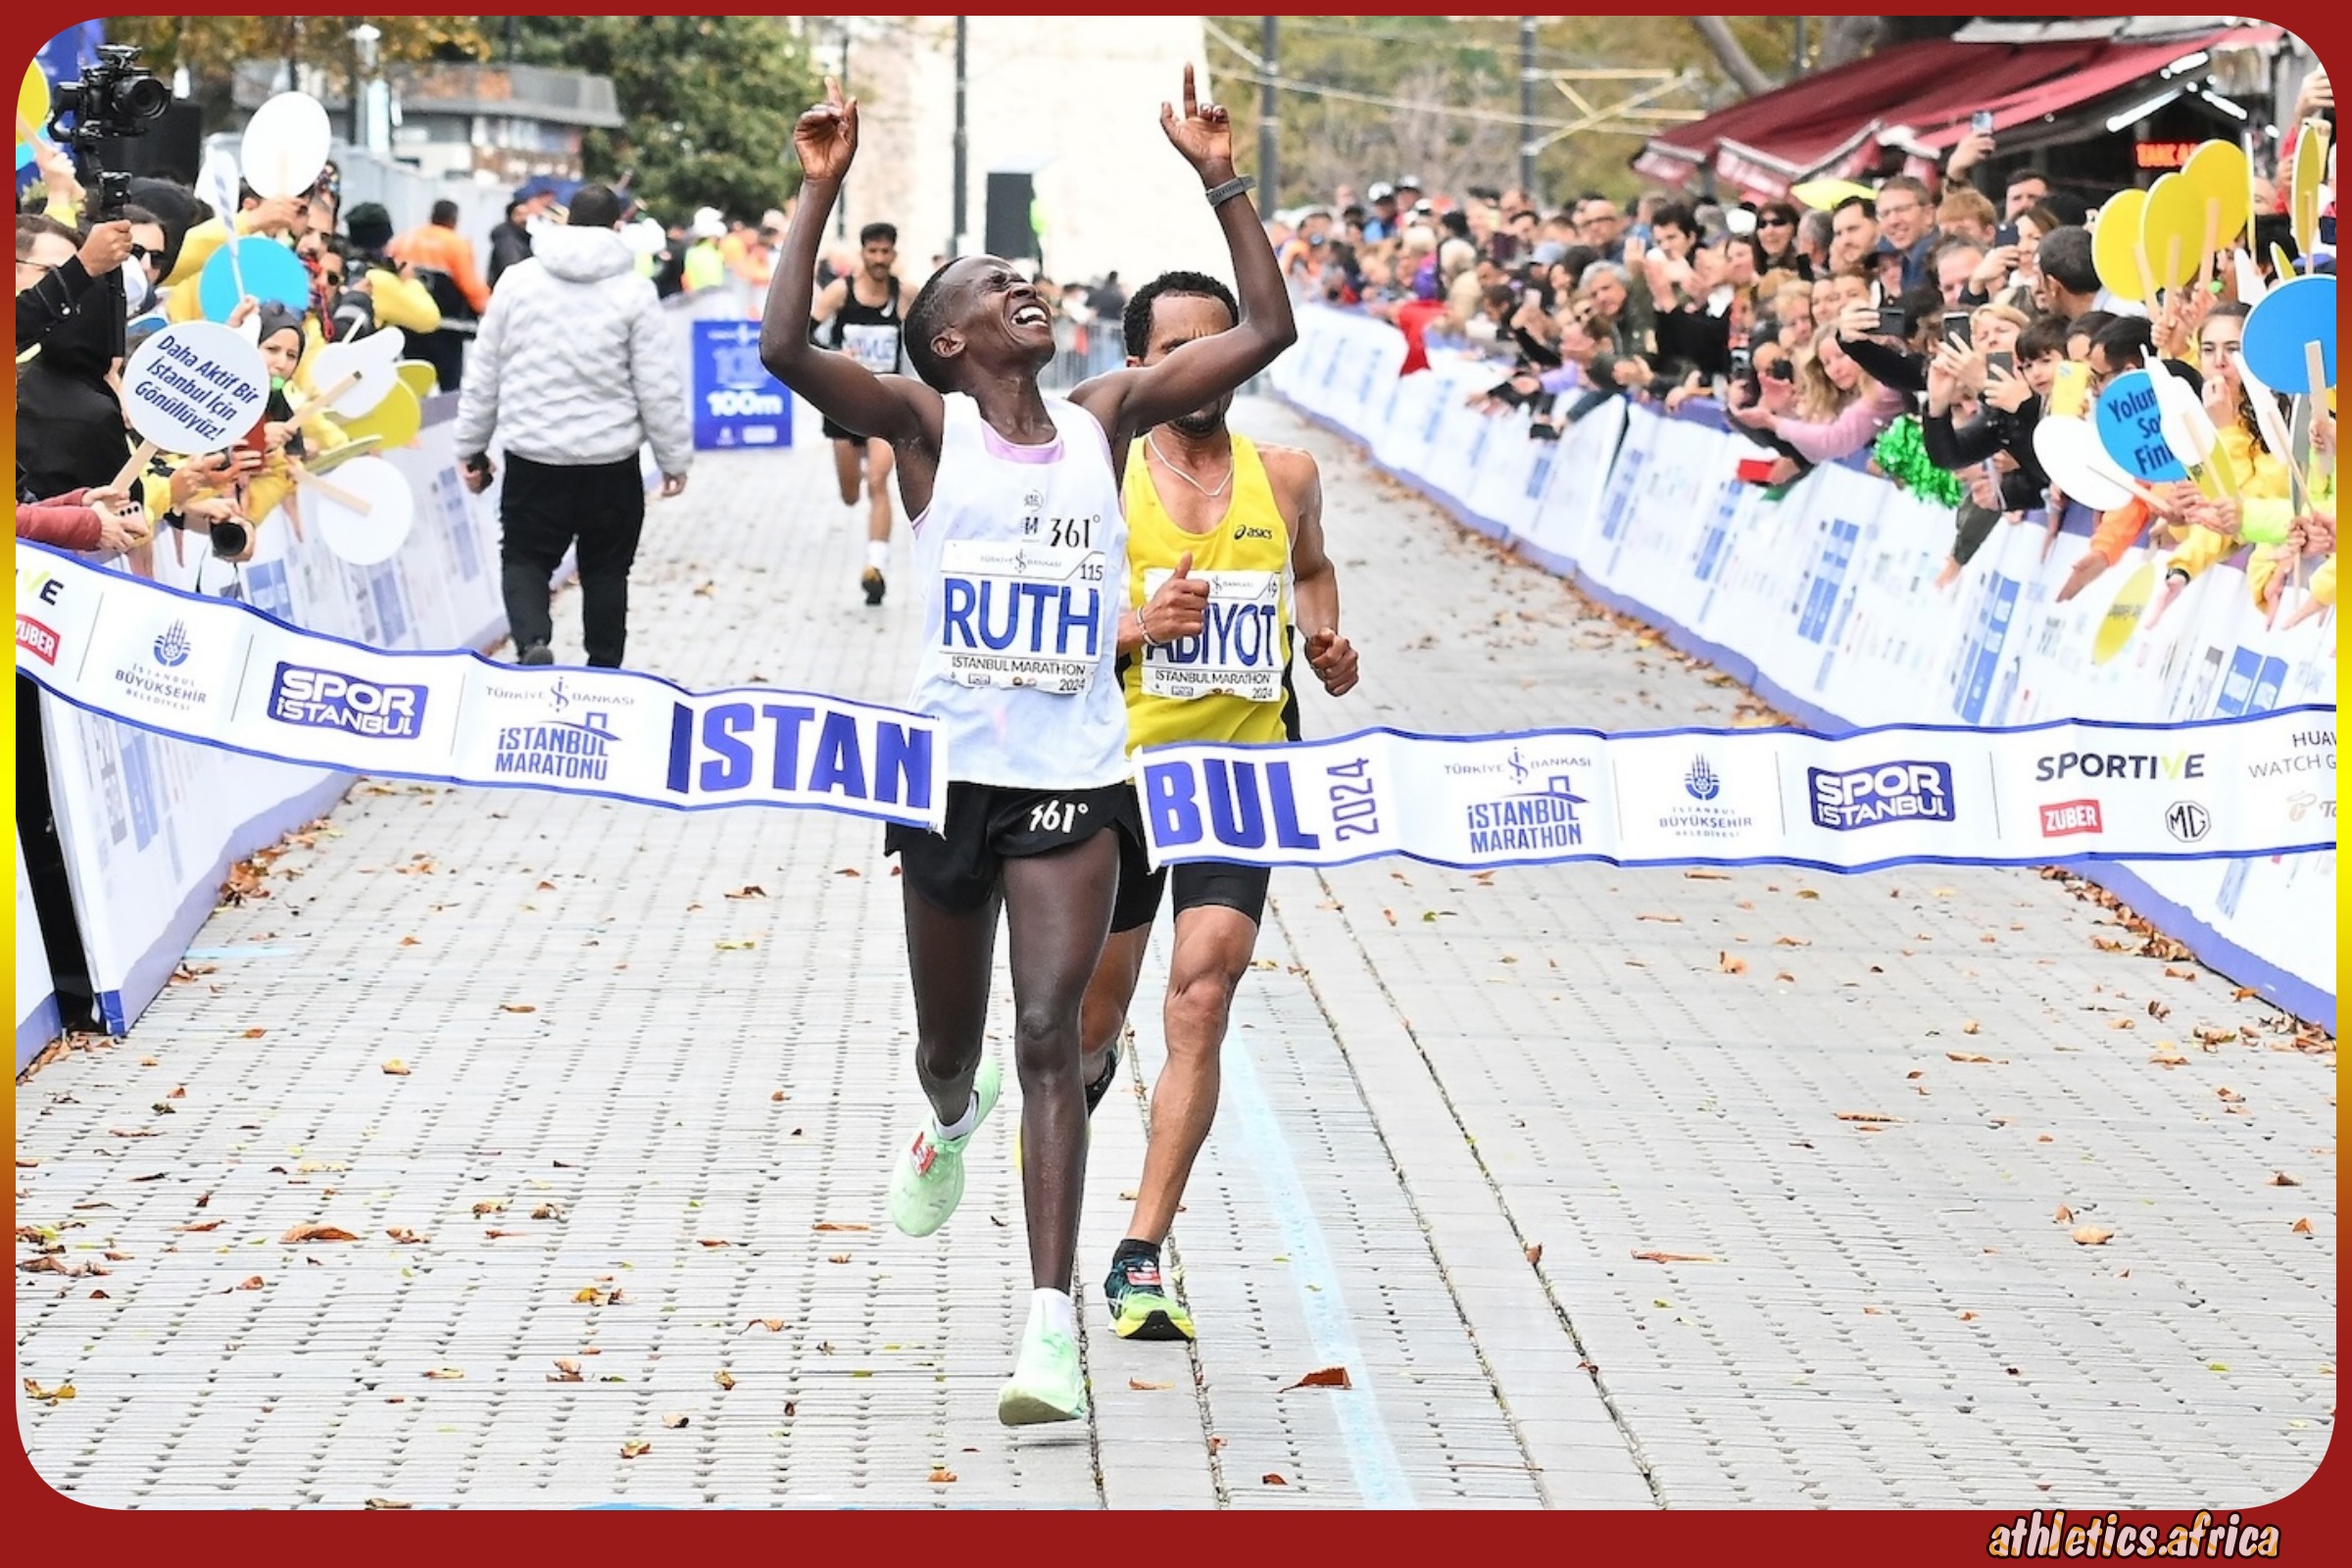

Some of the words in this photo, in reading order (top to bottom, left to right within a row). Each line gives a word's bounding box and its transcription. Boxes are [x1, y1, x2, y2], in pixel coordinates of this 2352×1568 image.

[146, 356, 213, 405] İstanbul
[157, 335, 199, 368] Daha
[194, 361, 240, 390] Aktif
[232, 383, 260, 404] Bir
[135, 380, 226, 441] Gönüllüyüz!
[707, 391, 783, 416] 100m
[2137, 416, 2161, 440] So
[1080, 564, 1103, 581] 115
[943, 577, 1100, 656] RUTH
[1147, 603, 1276, 666] IYOT
[1011, 661, 1086, 676] MARATHON
[1058, 678, 1087, 691] 2024
[1212, 672, 1270, 685] MARATHON
[280, 669, 416, 716] SPOR
[495, 753, 608, 781] MARATONU
[666, 701, 933, 809] ISTAN
[2035, 750, 2205, 782] SPORTIVE
[2248, 754, 2322, 778] WATCH
[1816, 765, 1944, 806] SPOR
[1144, 759, 1320, 850] BUL
[1327, 757, 1379, 842] 2024
[2043, 806, 2098, 832] ZUBER
[2170, 805, 2206, 839] MG
[1470, 823, 1583, 854] MARATHON
